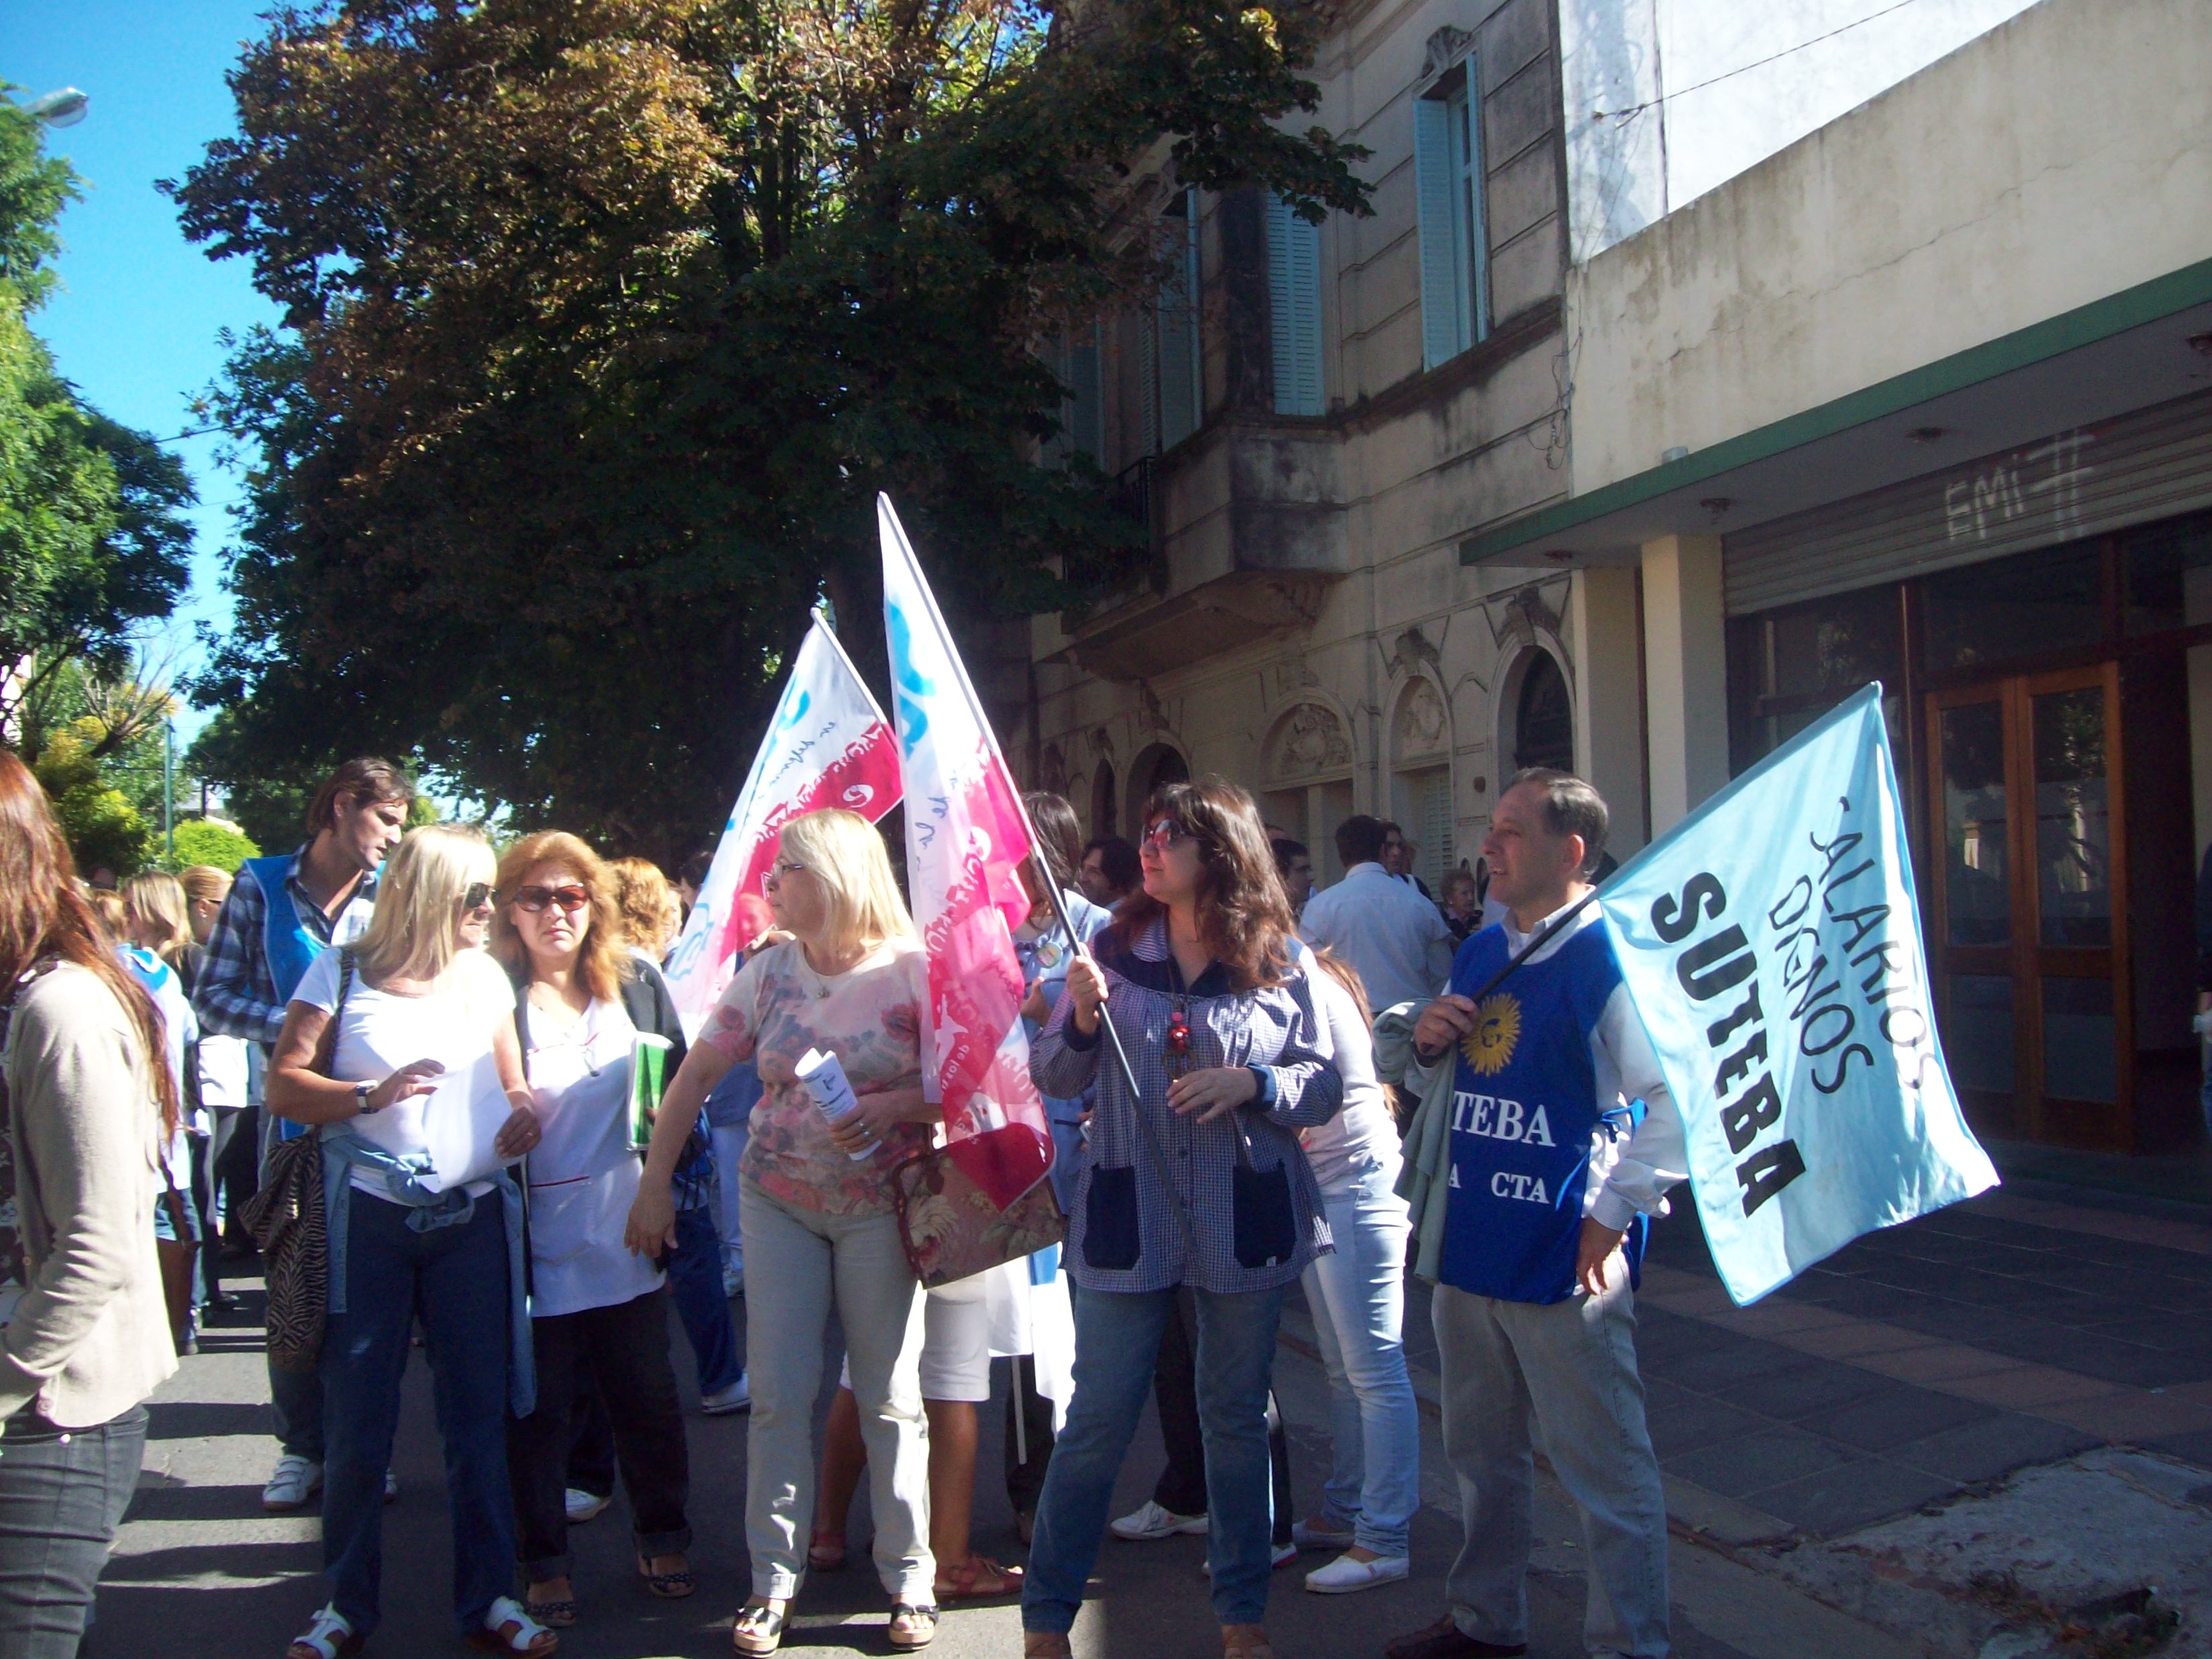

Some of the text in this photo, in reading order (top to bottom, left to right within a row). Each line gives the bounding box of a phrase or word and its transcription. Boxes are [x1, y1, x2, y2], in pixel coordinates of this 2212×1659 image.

[1651, 872, 1807, 1217] SUTEBA
[1768, 874, 1874, 1095] DIGNOS
[1452, 1091, 1557, 1147] TEBA
[1491, 1172, 1550, 1204] CTA
